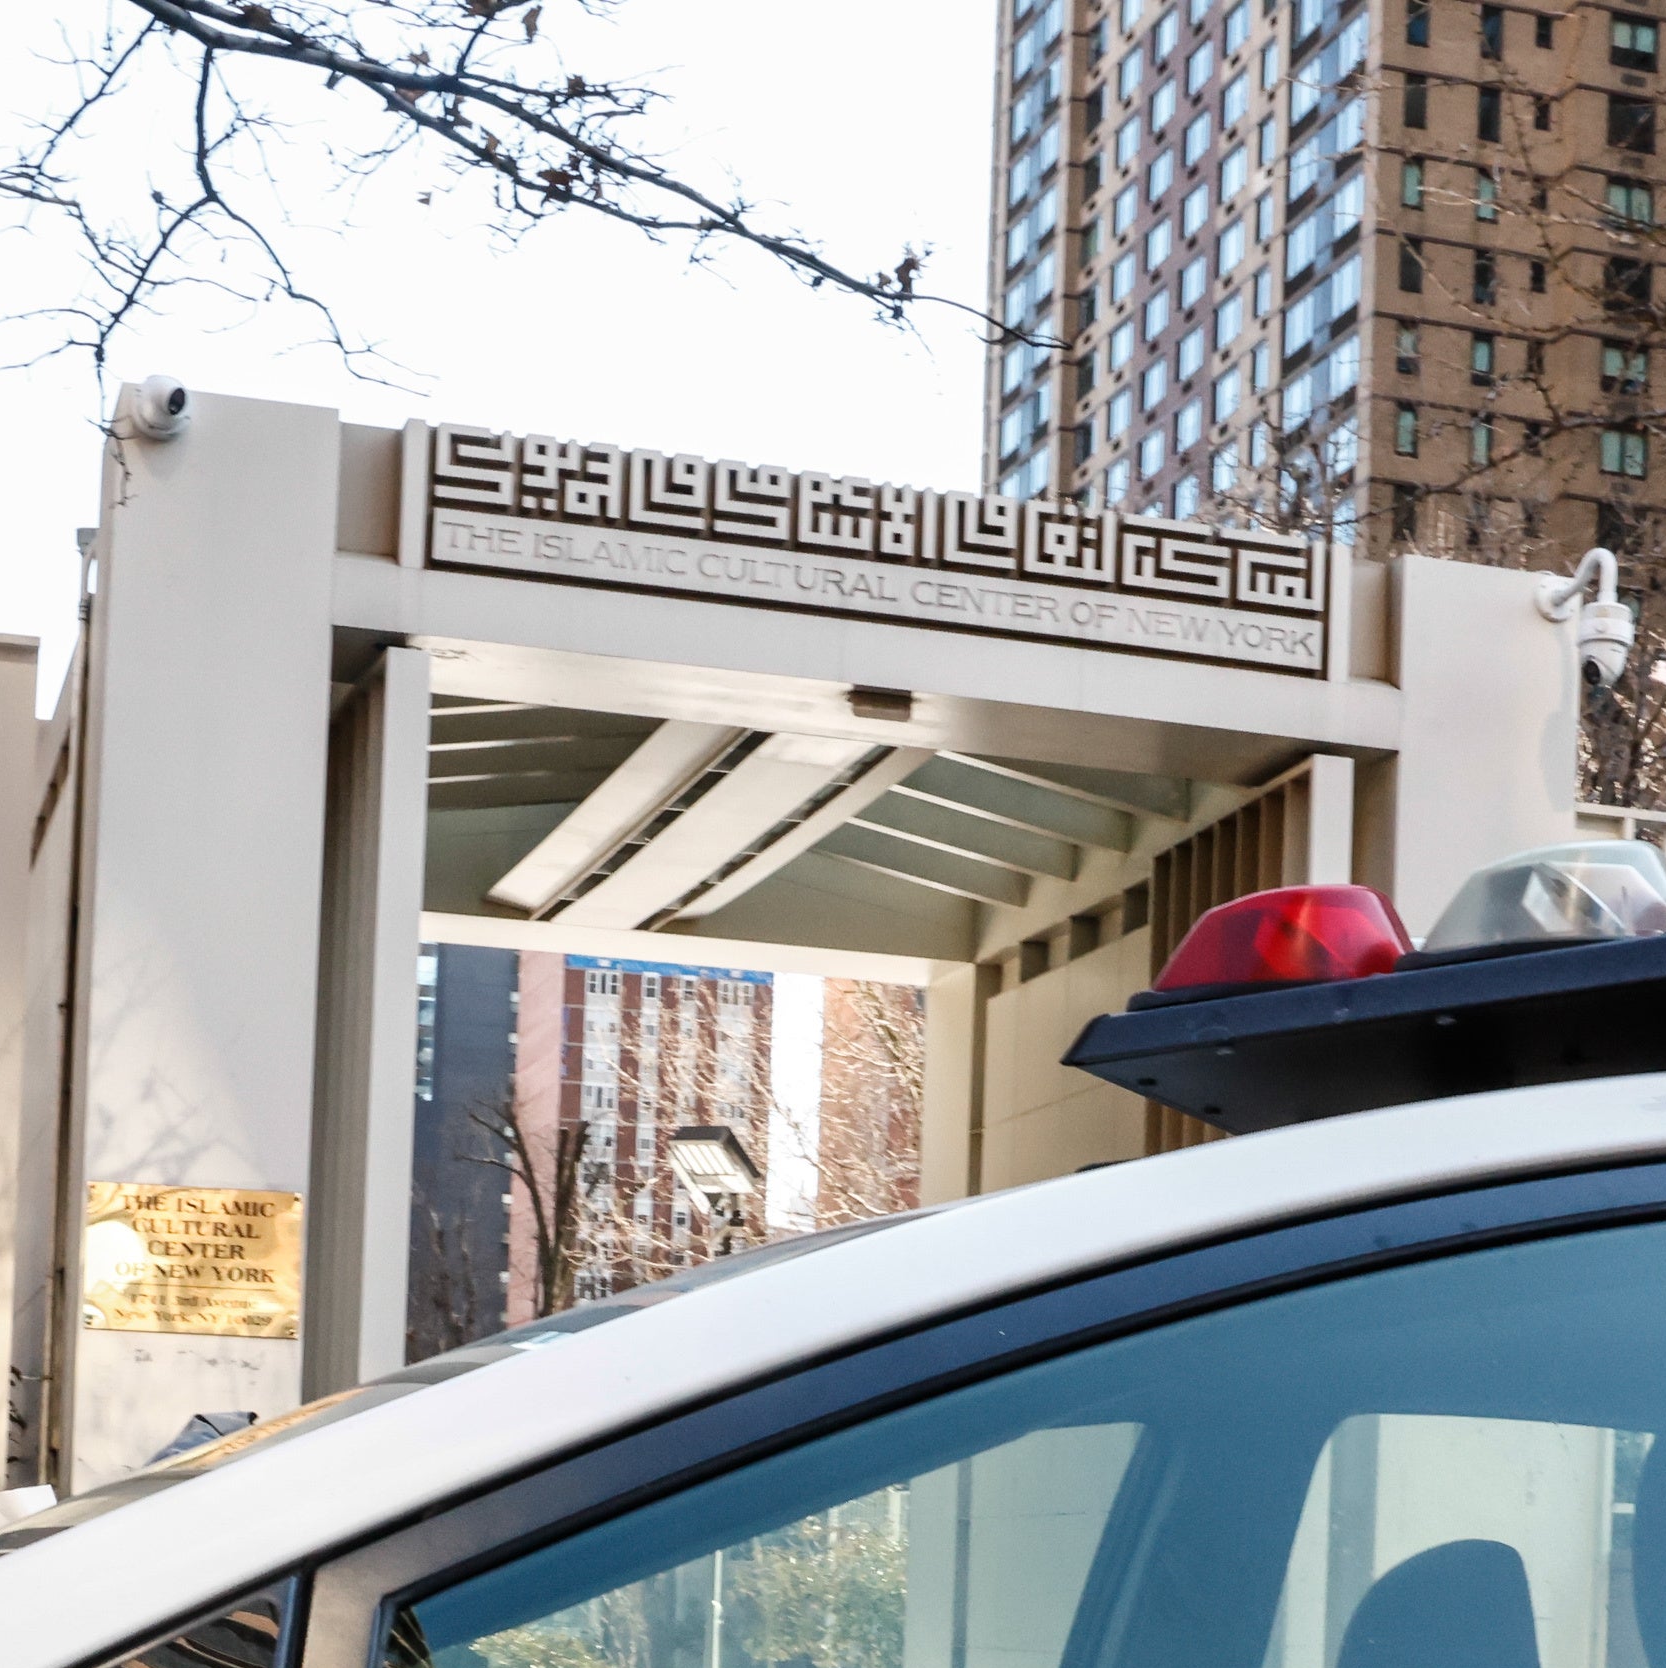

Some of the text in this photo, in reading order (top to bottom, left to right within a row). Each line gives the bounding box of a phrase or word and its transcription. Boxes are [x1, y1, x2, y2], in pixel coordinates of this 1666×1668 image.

[440, 520, 1317, 658] THE ISLAMIC CULTURAL CENTER OF NEW YORK
[123, 1194, 276, 1218] THE ISLAMIC
[132, 1217, 262, 1239] CULTURAL
[147, 1240, 245, 1260] CENTER
[114, 1262, 276, 1284] OF NEW YORK
